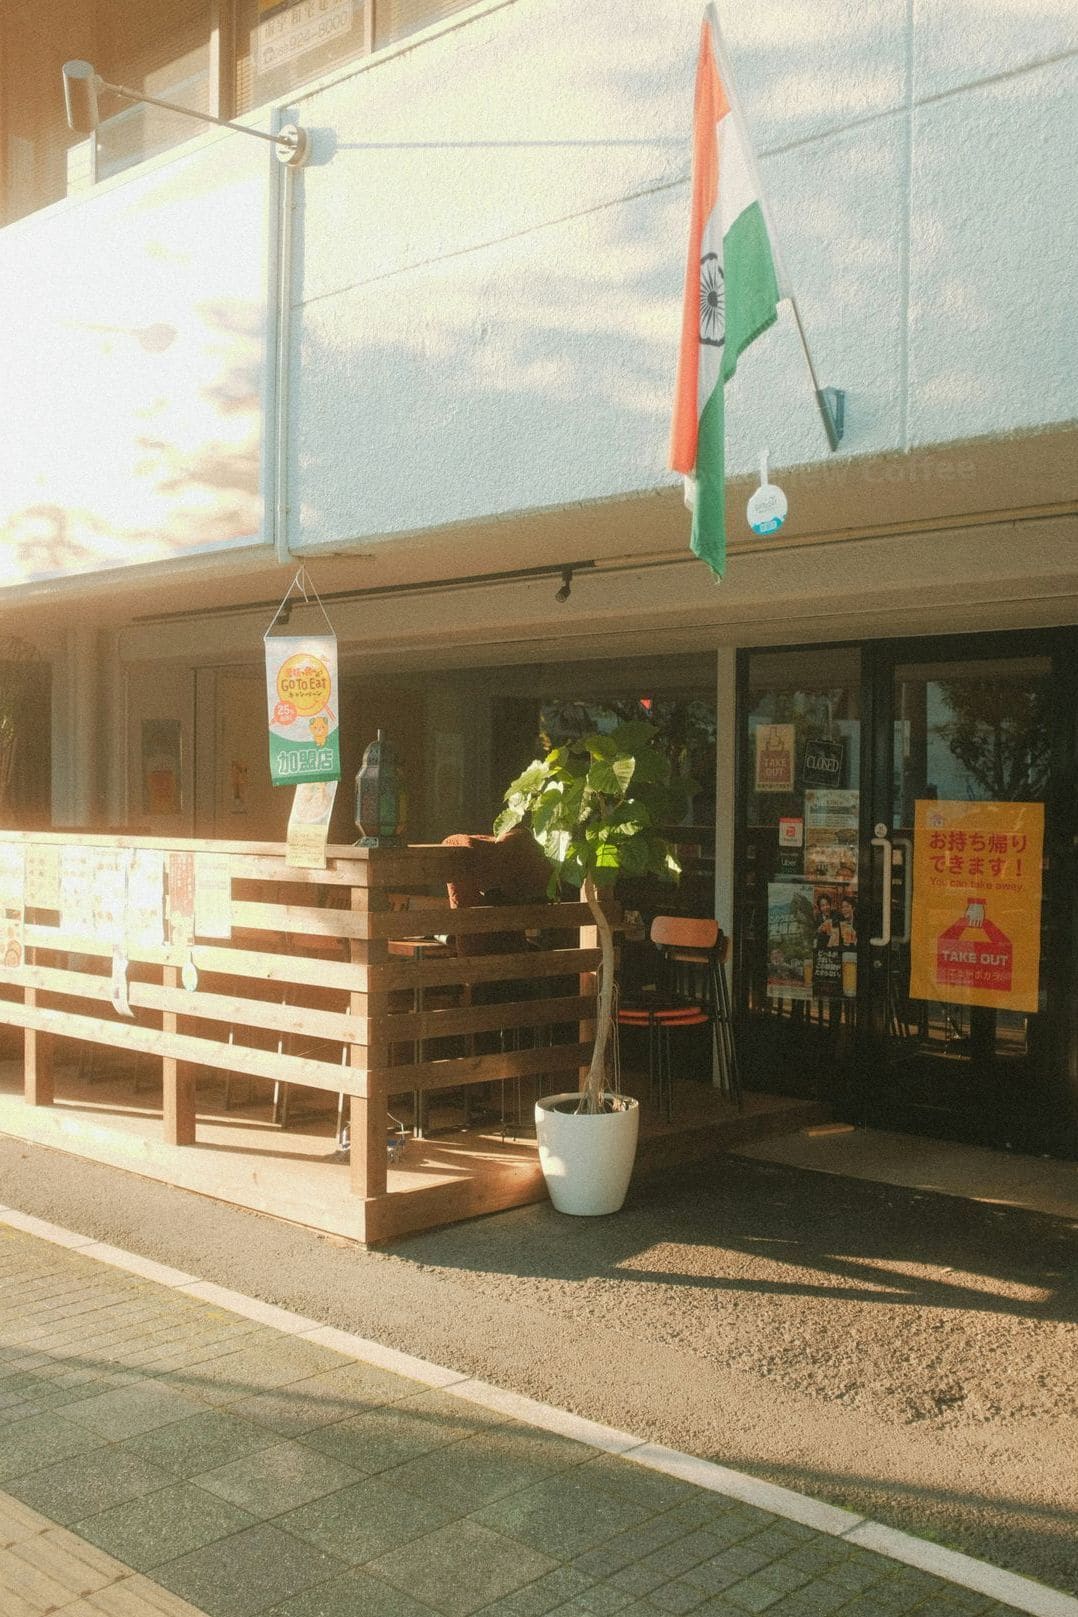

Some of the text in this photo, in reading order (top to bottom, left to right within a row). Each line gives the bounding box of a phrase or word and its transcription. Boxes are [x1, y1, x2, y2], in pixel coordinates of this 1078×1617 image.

[309, 677, 327, 690] Eat
[279, 749, 333, 774] 加盟店
[763, 758, 787, 768] TAKE
[806, 756, 840, 773] CLOSED
[765, 767, 784, 777] OUT
[929, 831, 1027, 854] お持ち帰り
[929, 855, 1023, 877] できます！
[930, 876, 948, 886] You
[949, 880, 968, 889] can
[970, 880, 992, 890] take
[942, 950, 1009, 967] TAKE OUT
